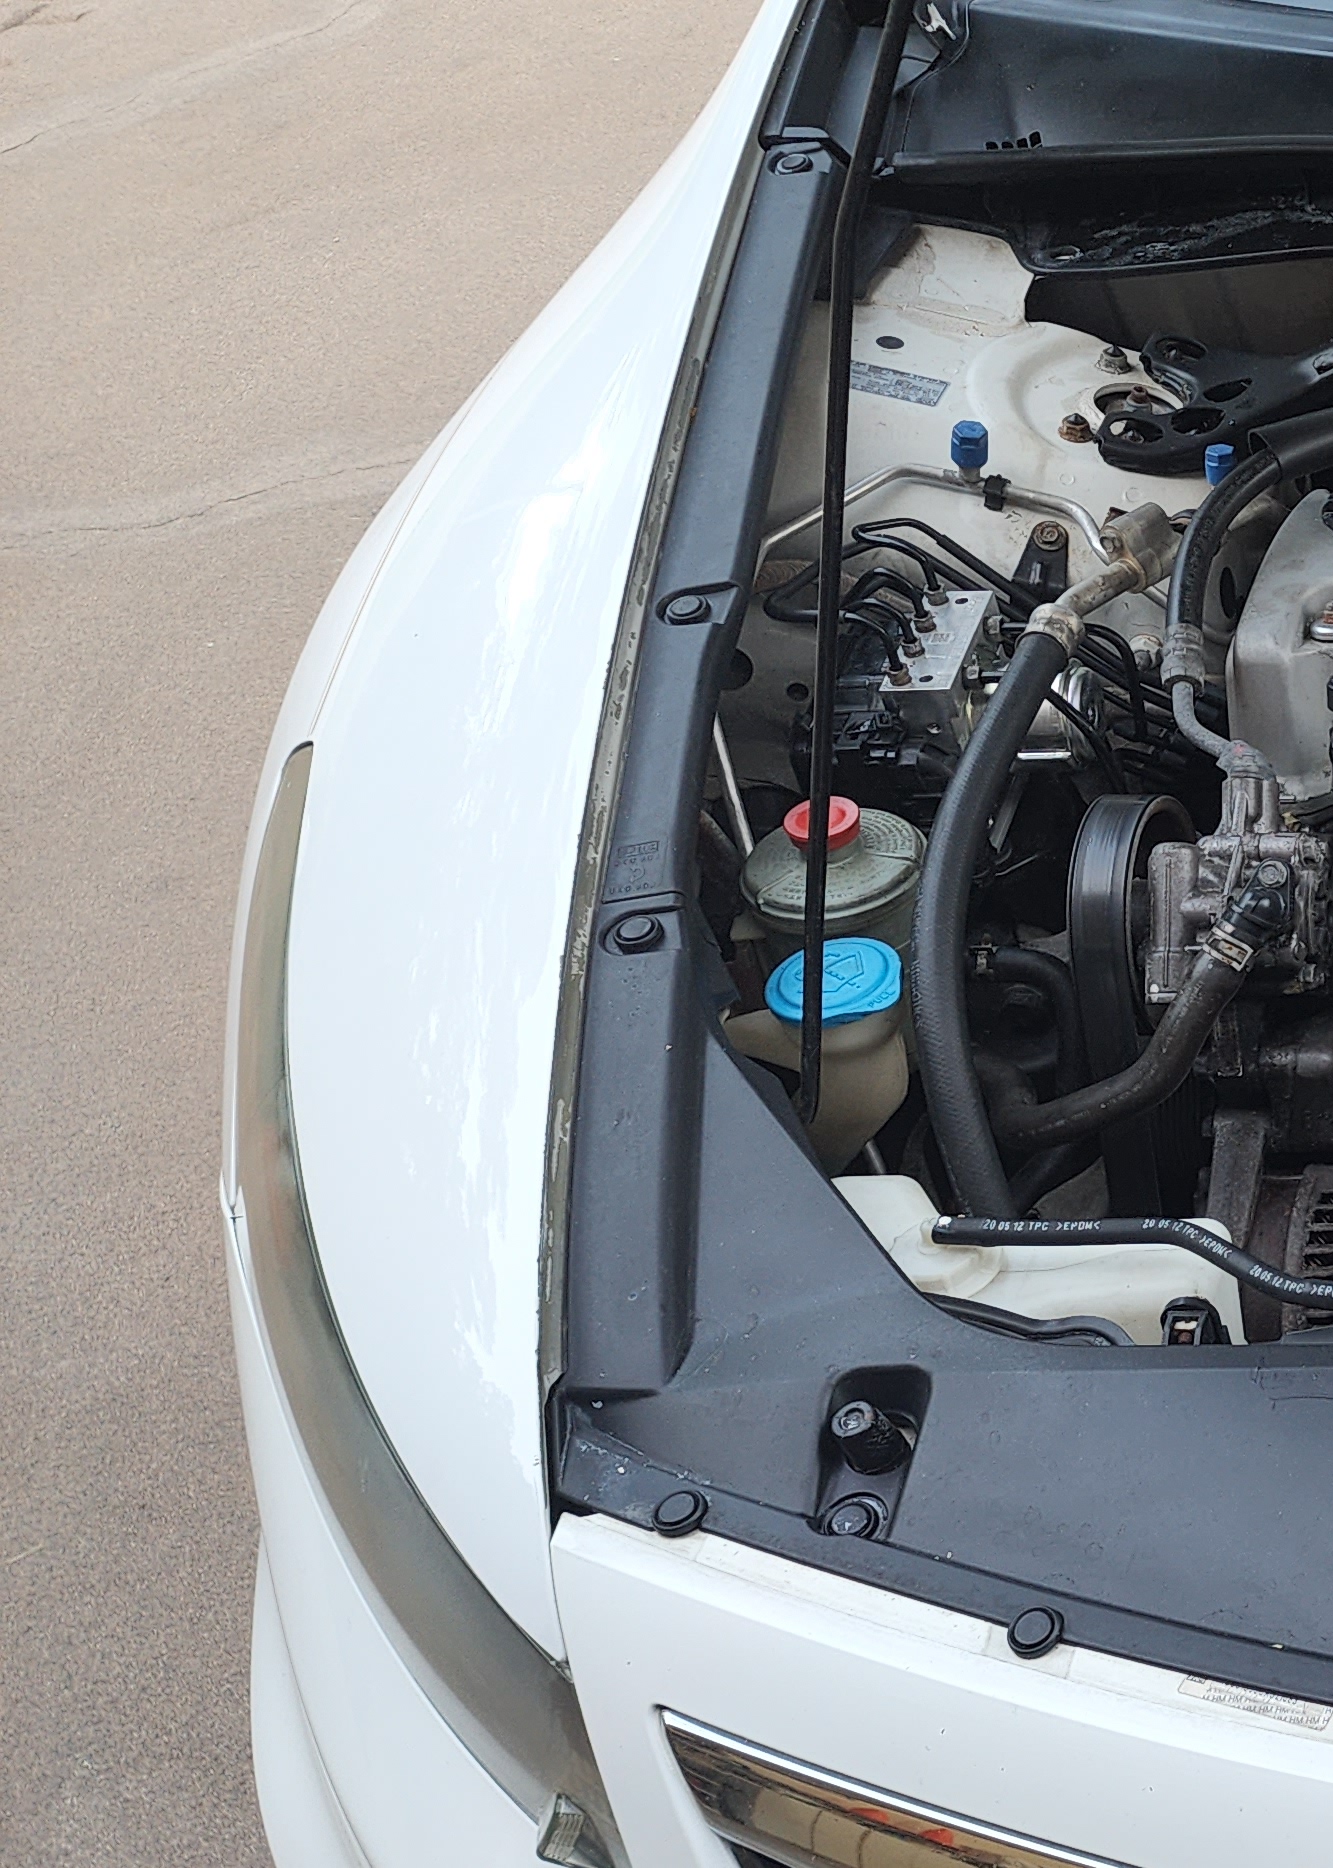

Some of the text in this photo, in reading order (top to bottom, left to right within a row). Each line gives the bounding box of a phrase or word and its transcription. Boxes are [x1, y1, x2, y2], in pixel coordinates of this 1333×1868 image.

[867, 990, 897, 1008] PULL
[983, 1218, 996, 1230] 20
[998, 1219, 1010, 1230] 05
[1012, 1220, 1024, 1231] 12
[1028, 1219, 1050, 1231] TPC
[1142, 1218, 1155, 1229] 20
[1158, 1219, 1169, 1229] 05
[1171, 1221, 1182, 1231] 12
[1182, 1225, 1199, 1239] TPC
[1250, 1264, 1261, 1277] 20
[1260, 1269, 1271, 1282] 05
[1271, 1275, 1283, 1288] 12
[1282, 1279, 1304, 1294] TPC
